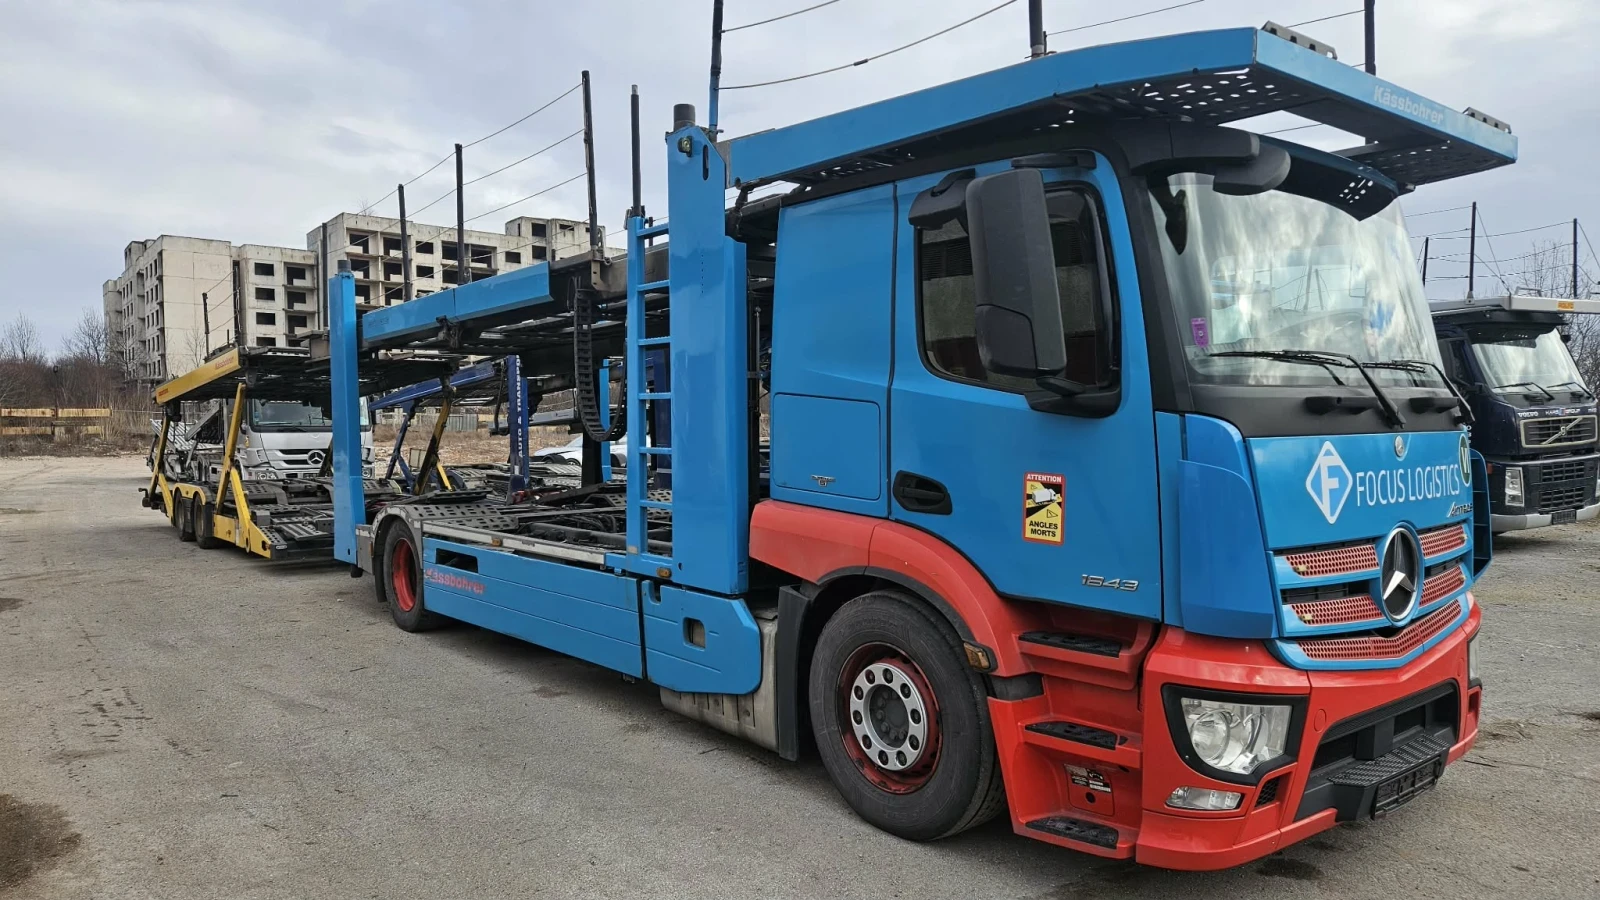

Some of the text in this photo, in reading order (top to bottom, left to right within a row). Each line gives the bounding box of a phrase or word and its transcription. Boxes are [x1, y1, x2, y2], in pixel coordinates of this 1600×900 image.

[1374, 85, 1444, 124] Kässbohrer
[1026, 473, 1062, 483] ATTENTION
[1356, 464, 1460, 507] FOCUS LOGISTICS
[1028, 520, 1058, 530] ANGLES
[1030, 528, 1056, 538] MORTS
